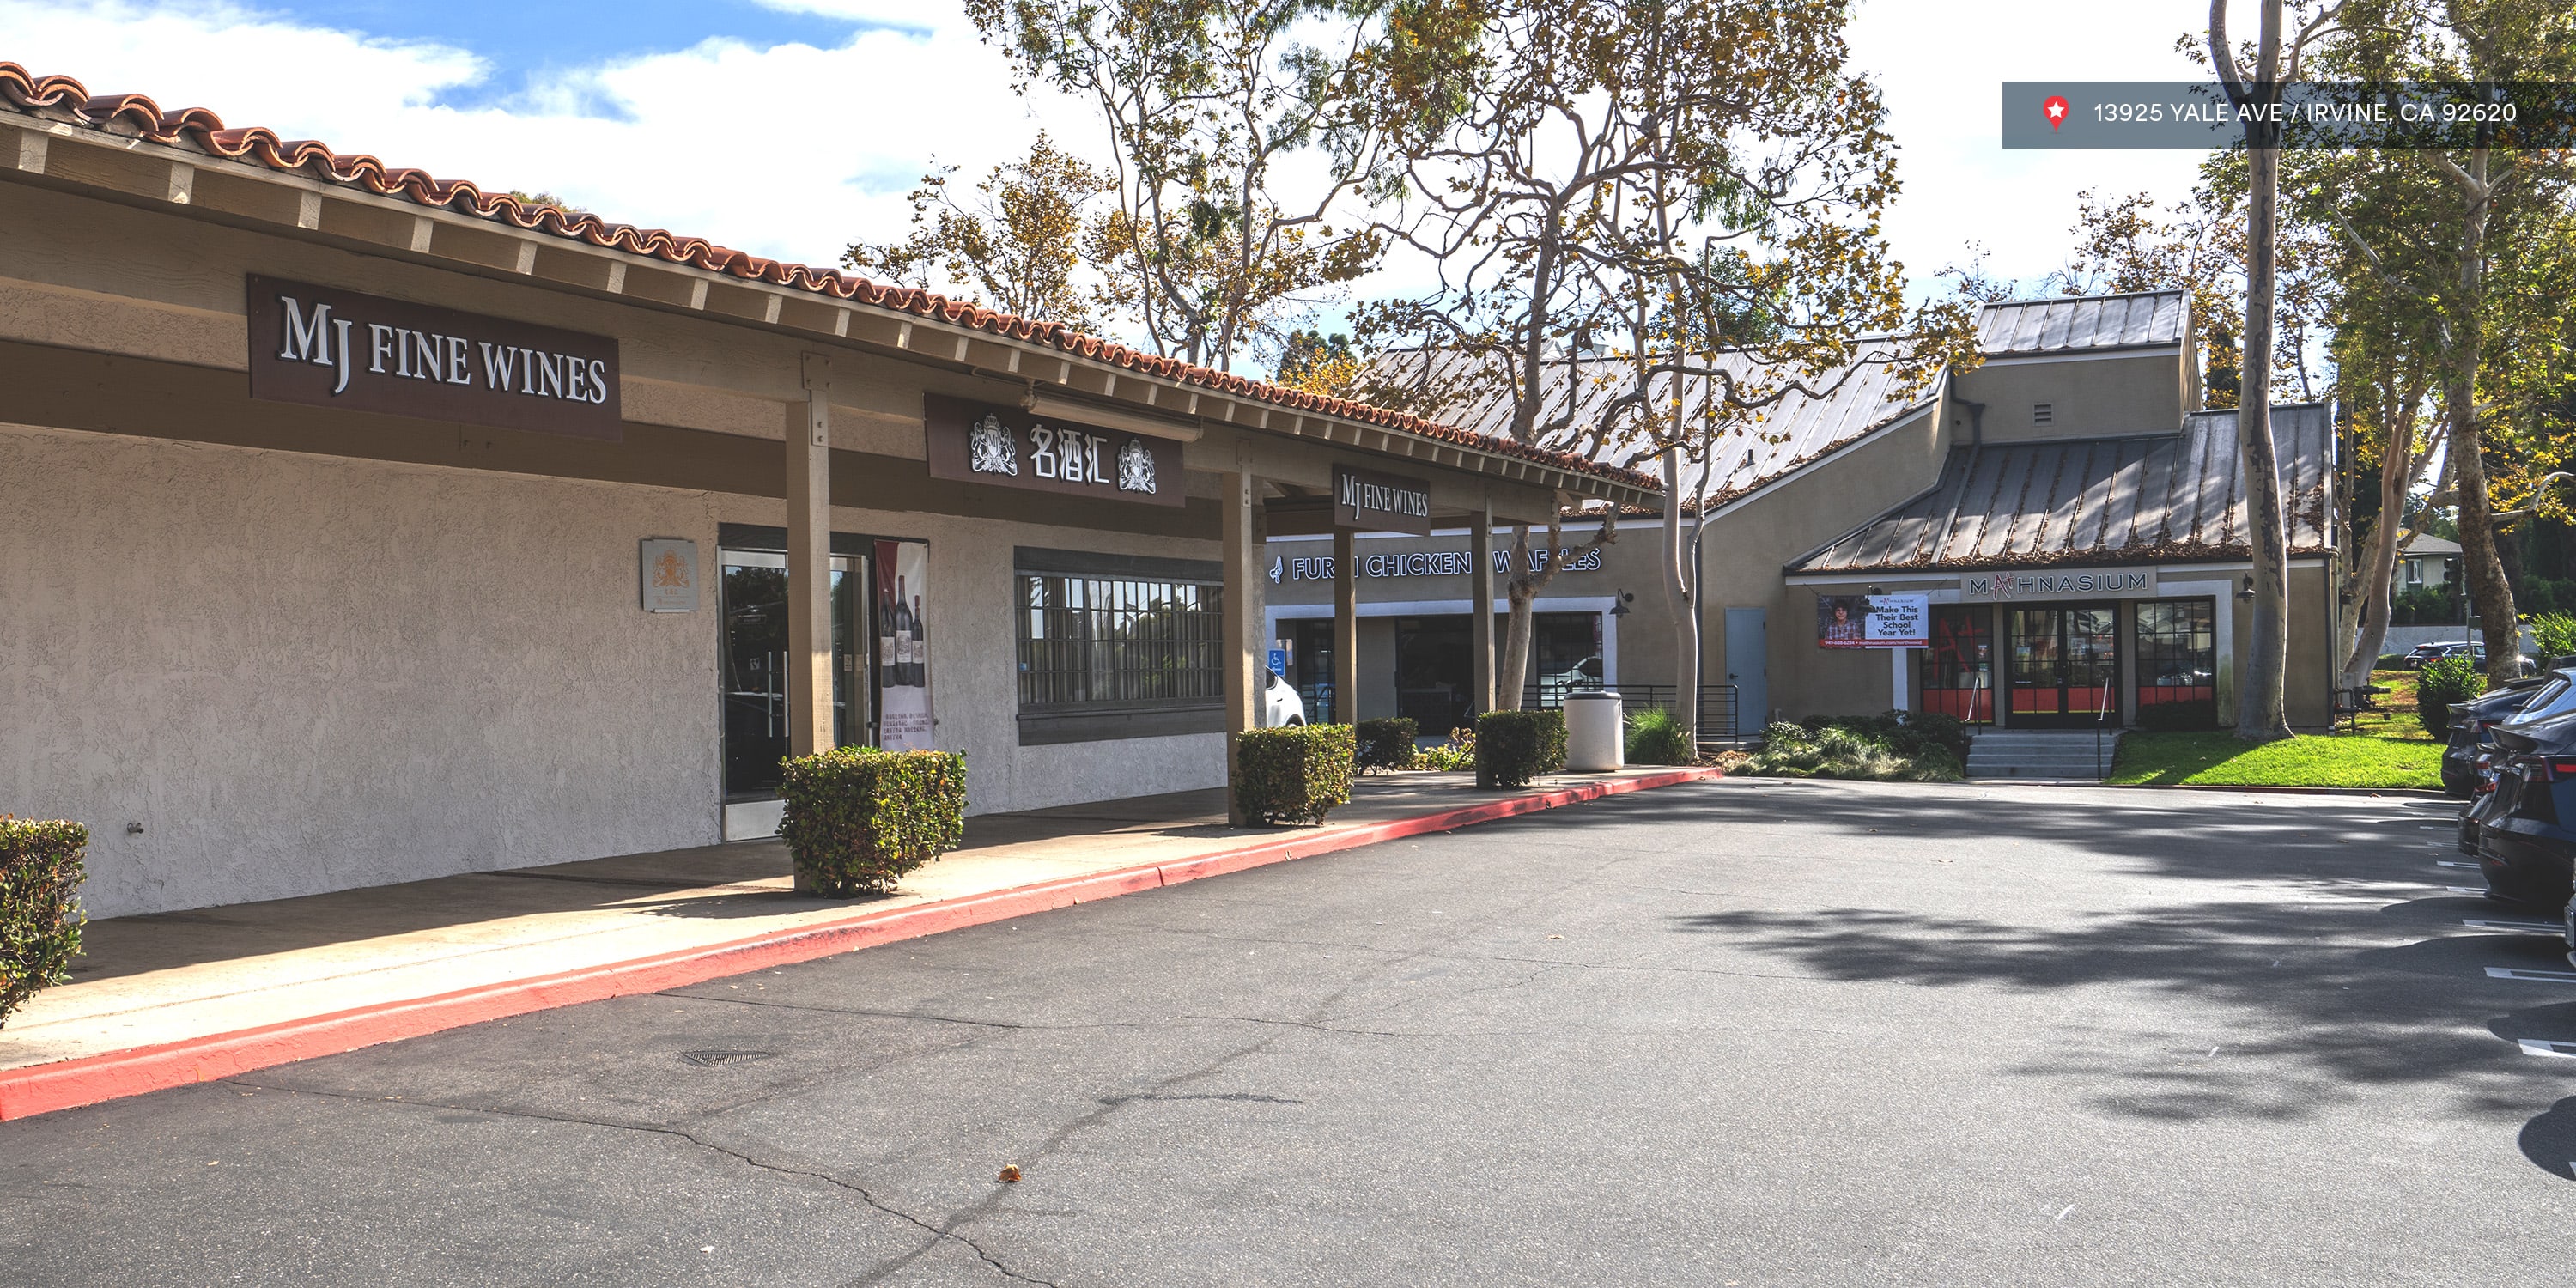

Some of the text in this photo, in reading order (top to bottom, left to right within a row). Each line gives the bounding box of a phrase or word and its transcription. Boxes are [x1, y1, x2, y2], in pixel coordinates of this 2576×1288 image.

[280, 295, 608, 404] MJ FINE WINES
[1030, 423, 1109, 483] 名酒汇
[1341, 473, 1428, 520] MJ FINE WINES
[1292, 556, 1359, 580] FUR
[1365, 551, 1473, 578] CHICKEN
